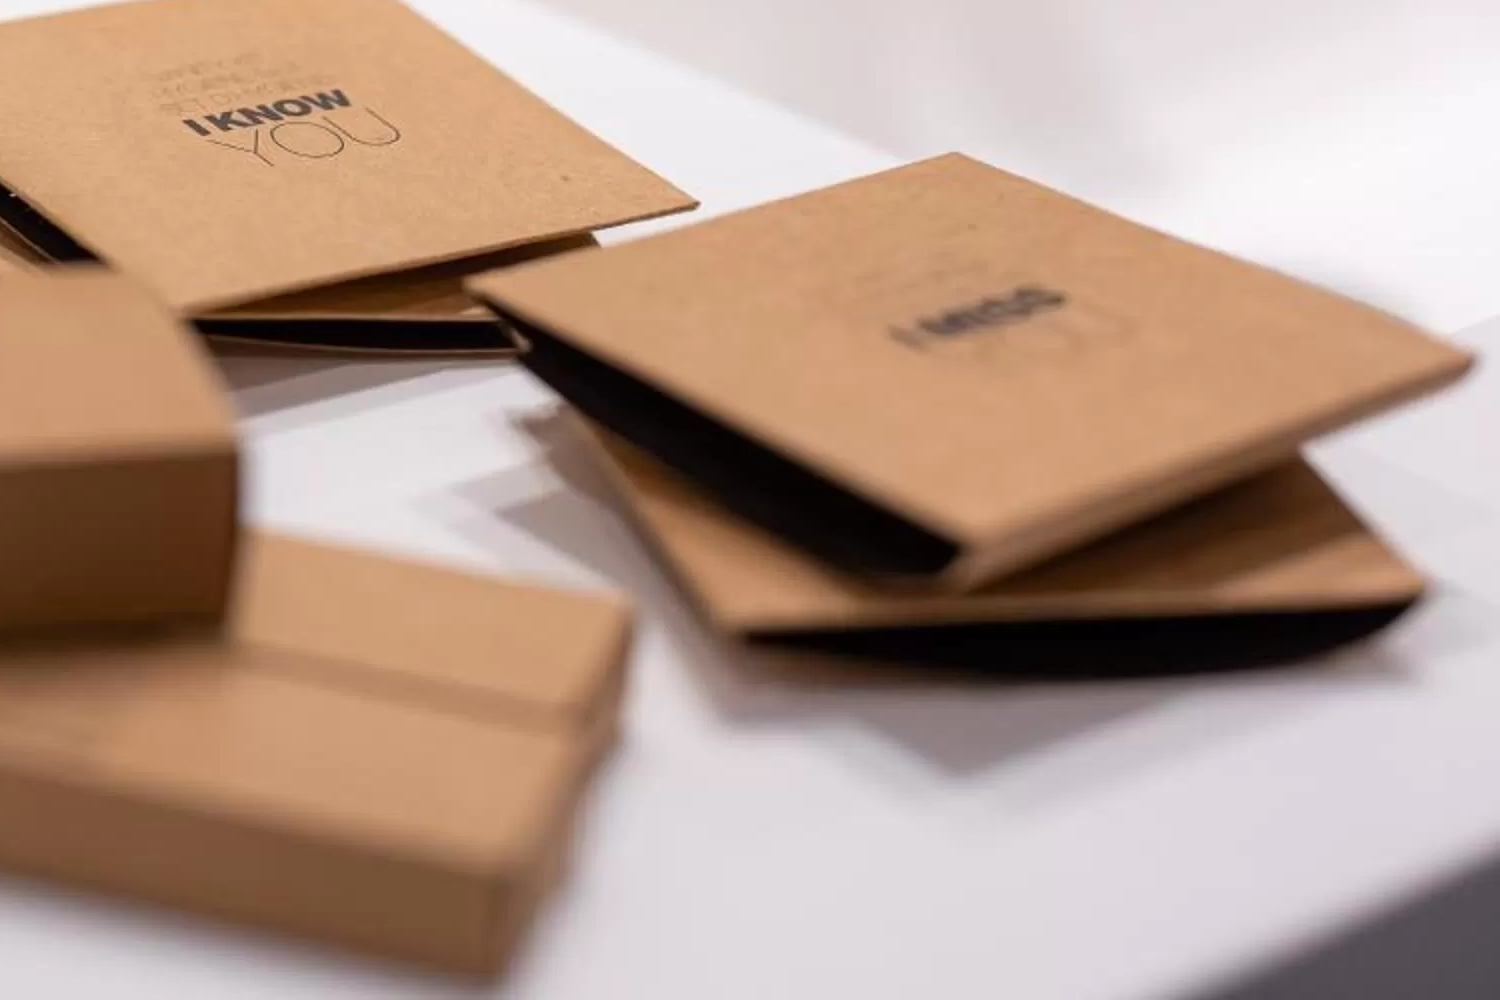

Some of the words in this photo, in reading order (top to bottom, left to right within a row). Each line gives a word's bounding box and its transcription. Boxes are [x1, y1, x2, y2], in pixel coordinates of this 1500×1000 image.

[182, 119, 211, 137] I
[205, 88, 352, 132] KNOW
[206, 107, 401, 167] YOU
